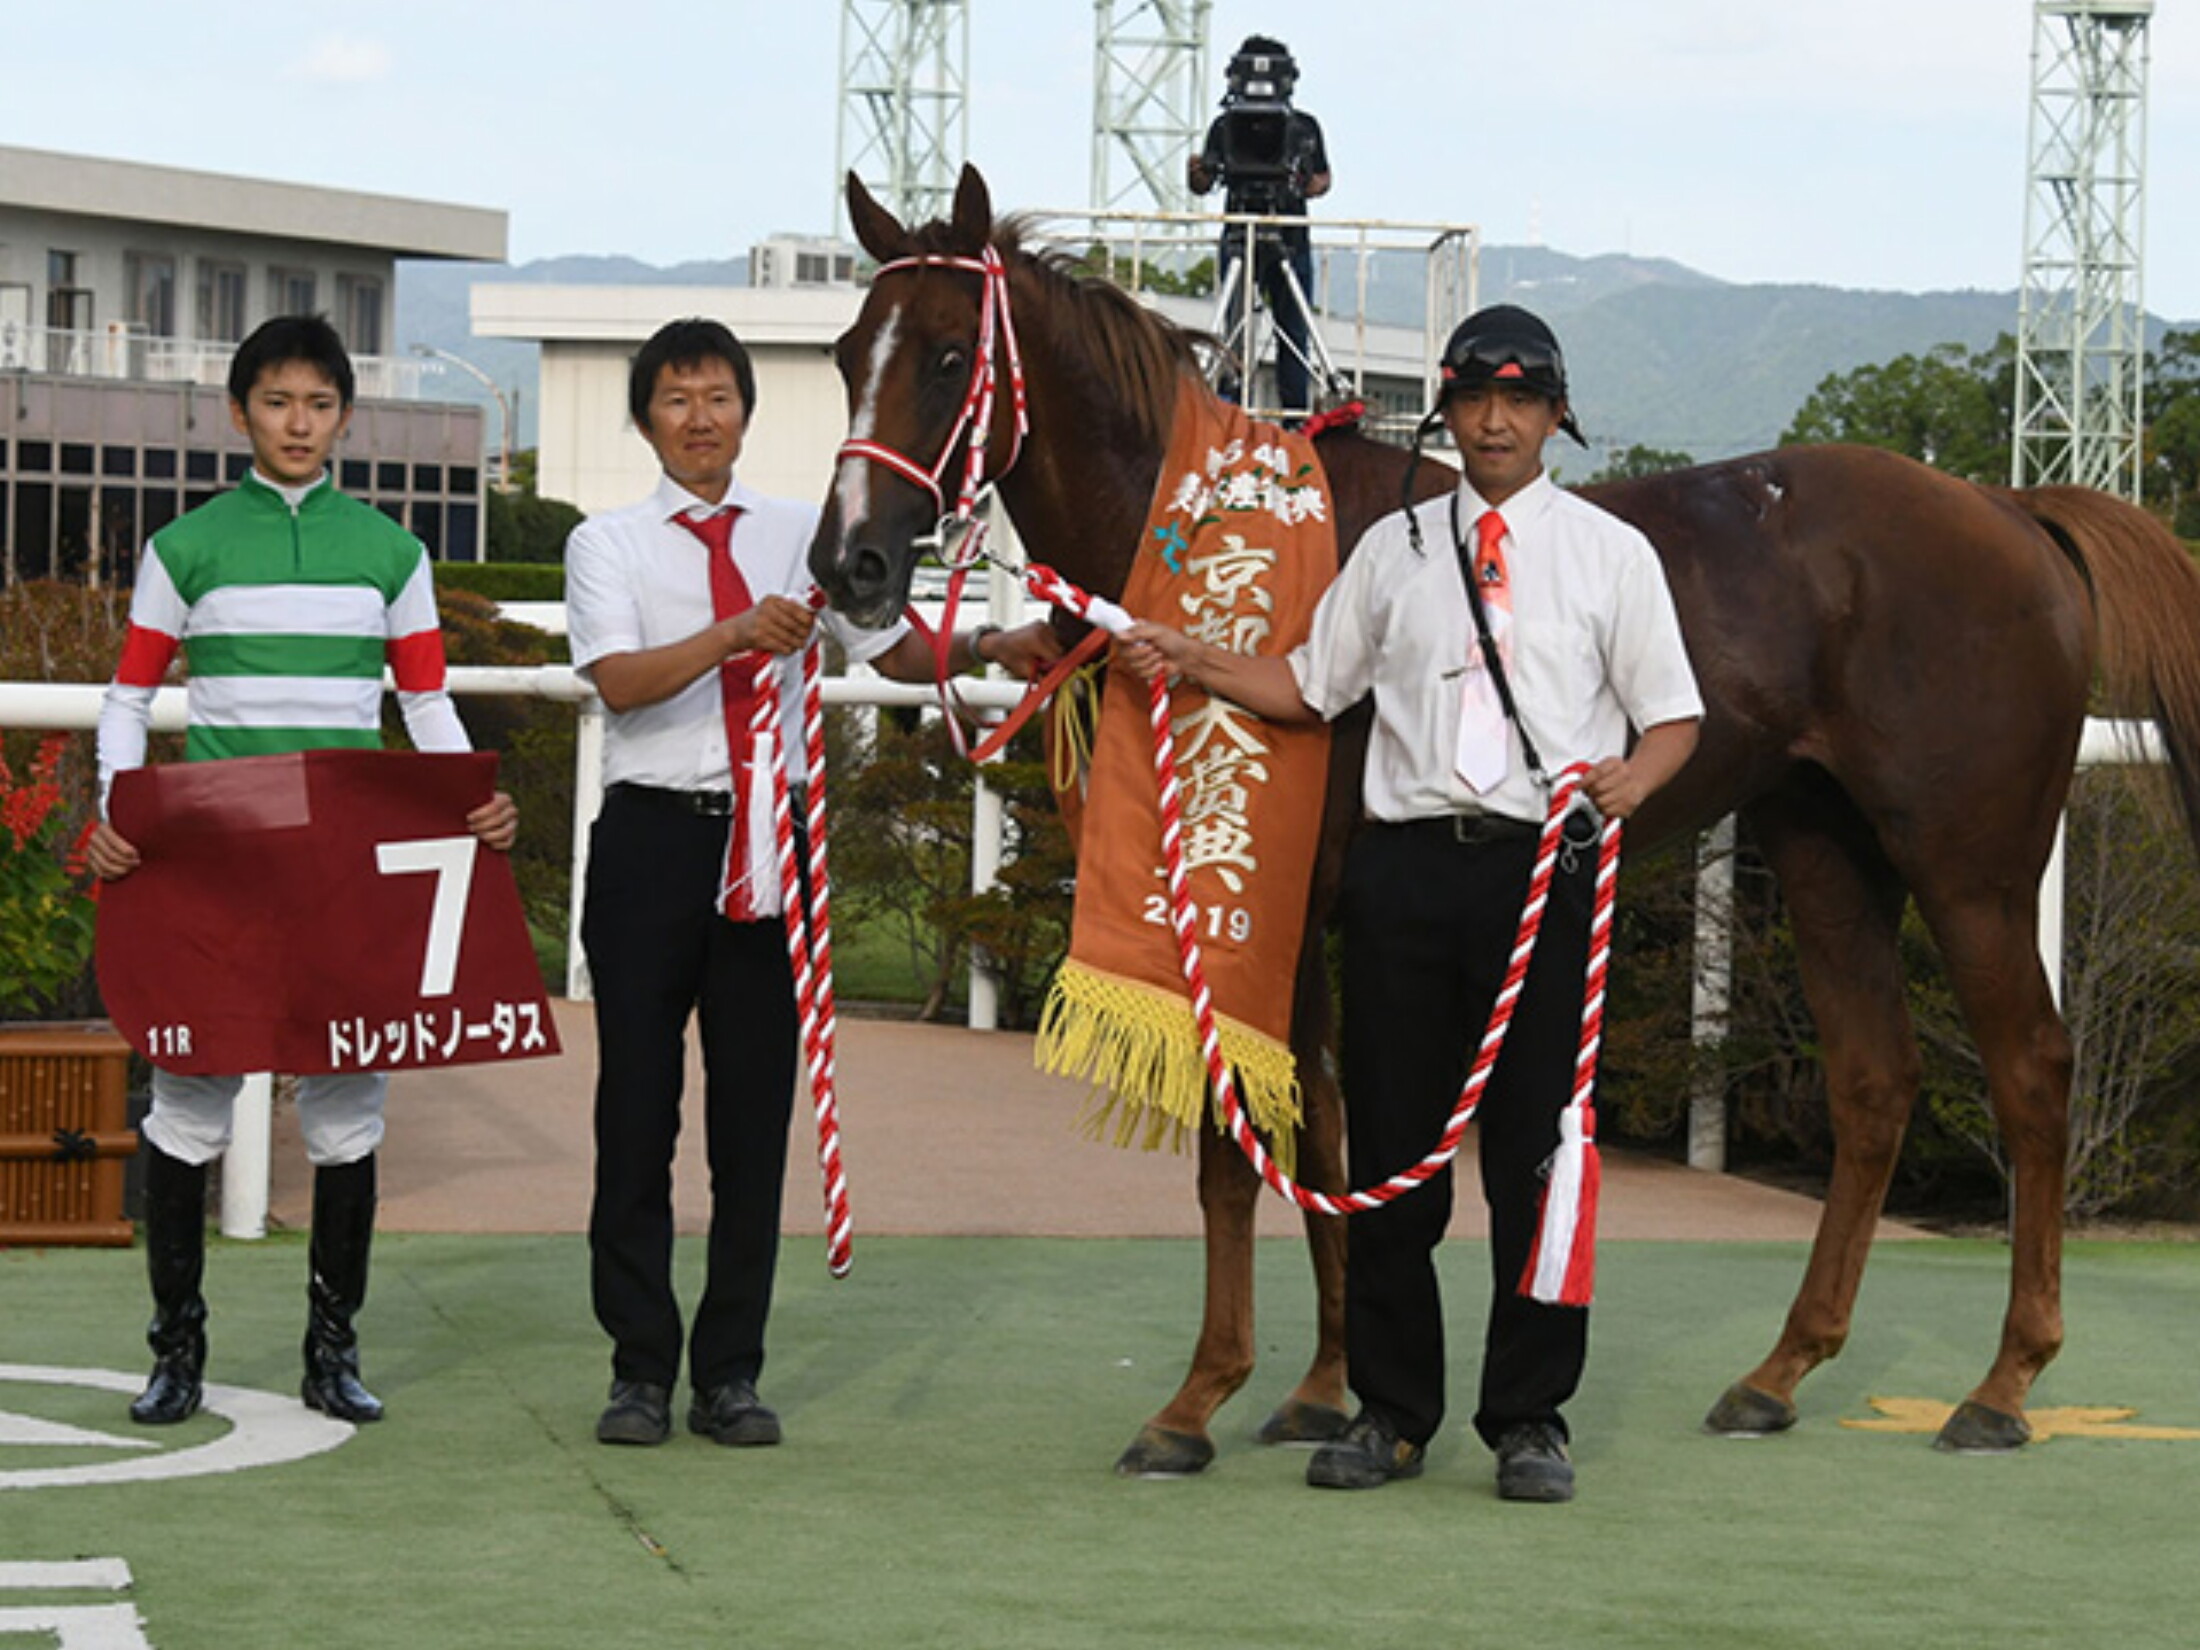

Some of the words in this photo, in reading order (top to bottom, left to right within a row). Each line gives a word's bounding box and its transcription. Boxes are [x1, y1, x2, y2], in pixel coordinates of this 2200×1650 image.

[375, 836, 478, 997] 7
[1143, 894, 1251, 941] 219
[146, 1024, 192, 1056] 11R
[328, 1002, 546, 1068] ドレッドノータス
